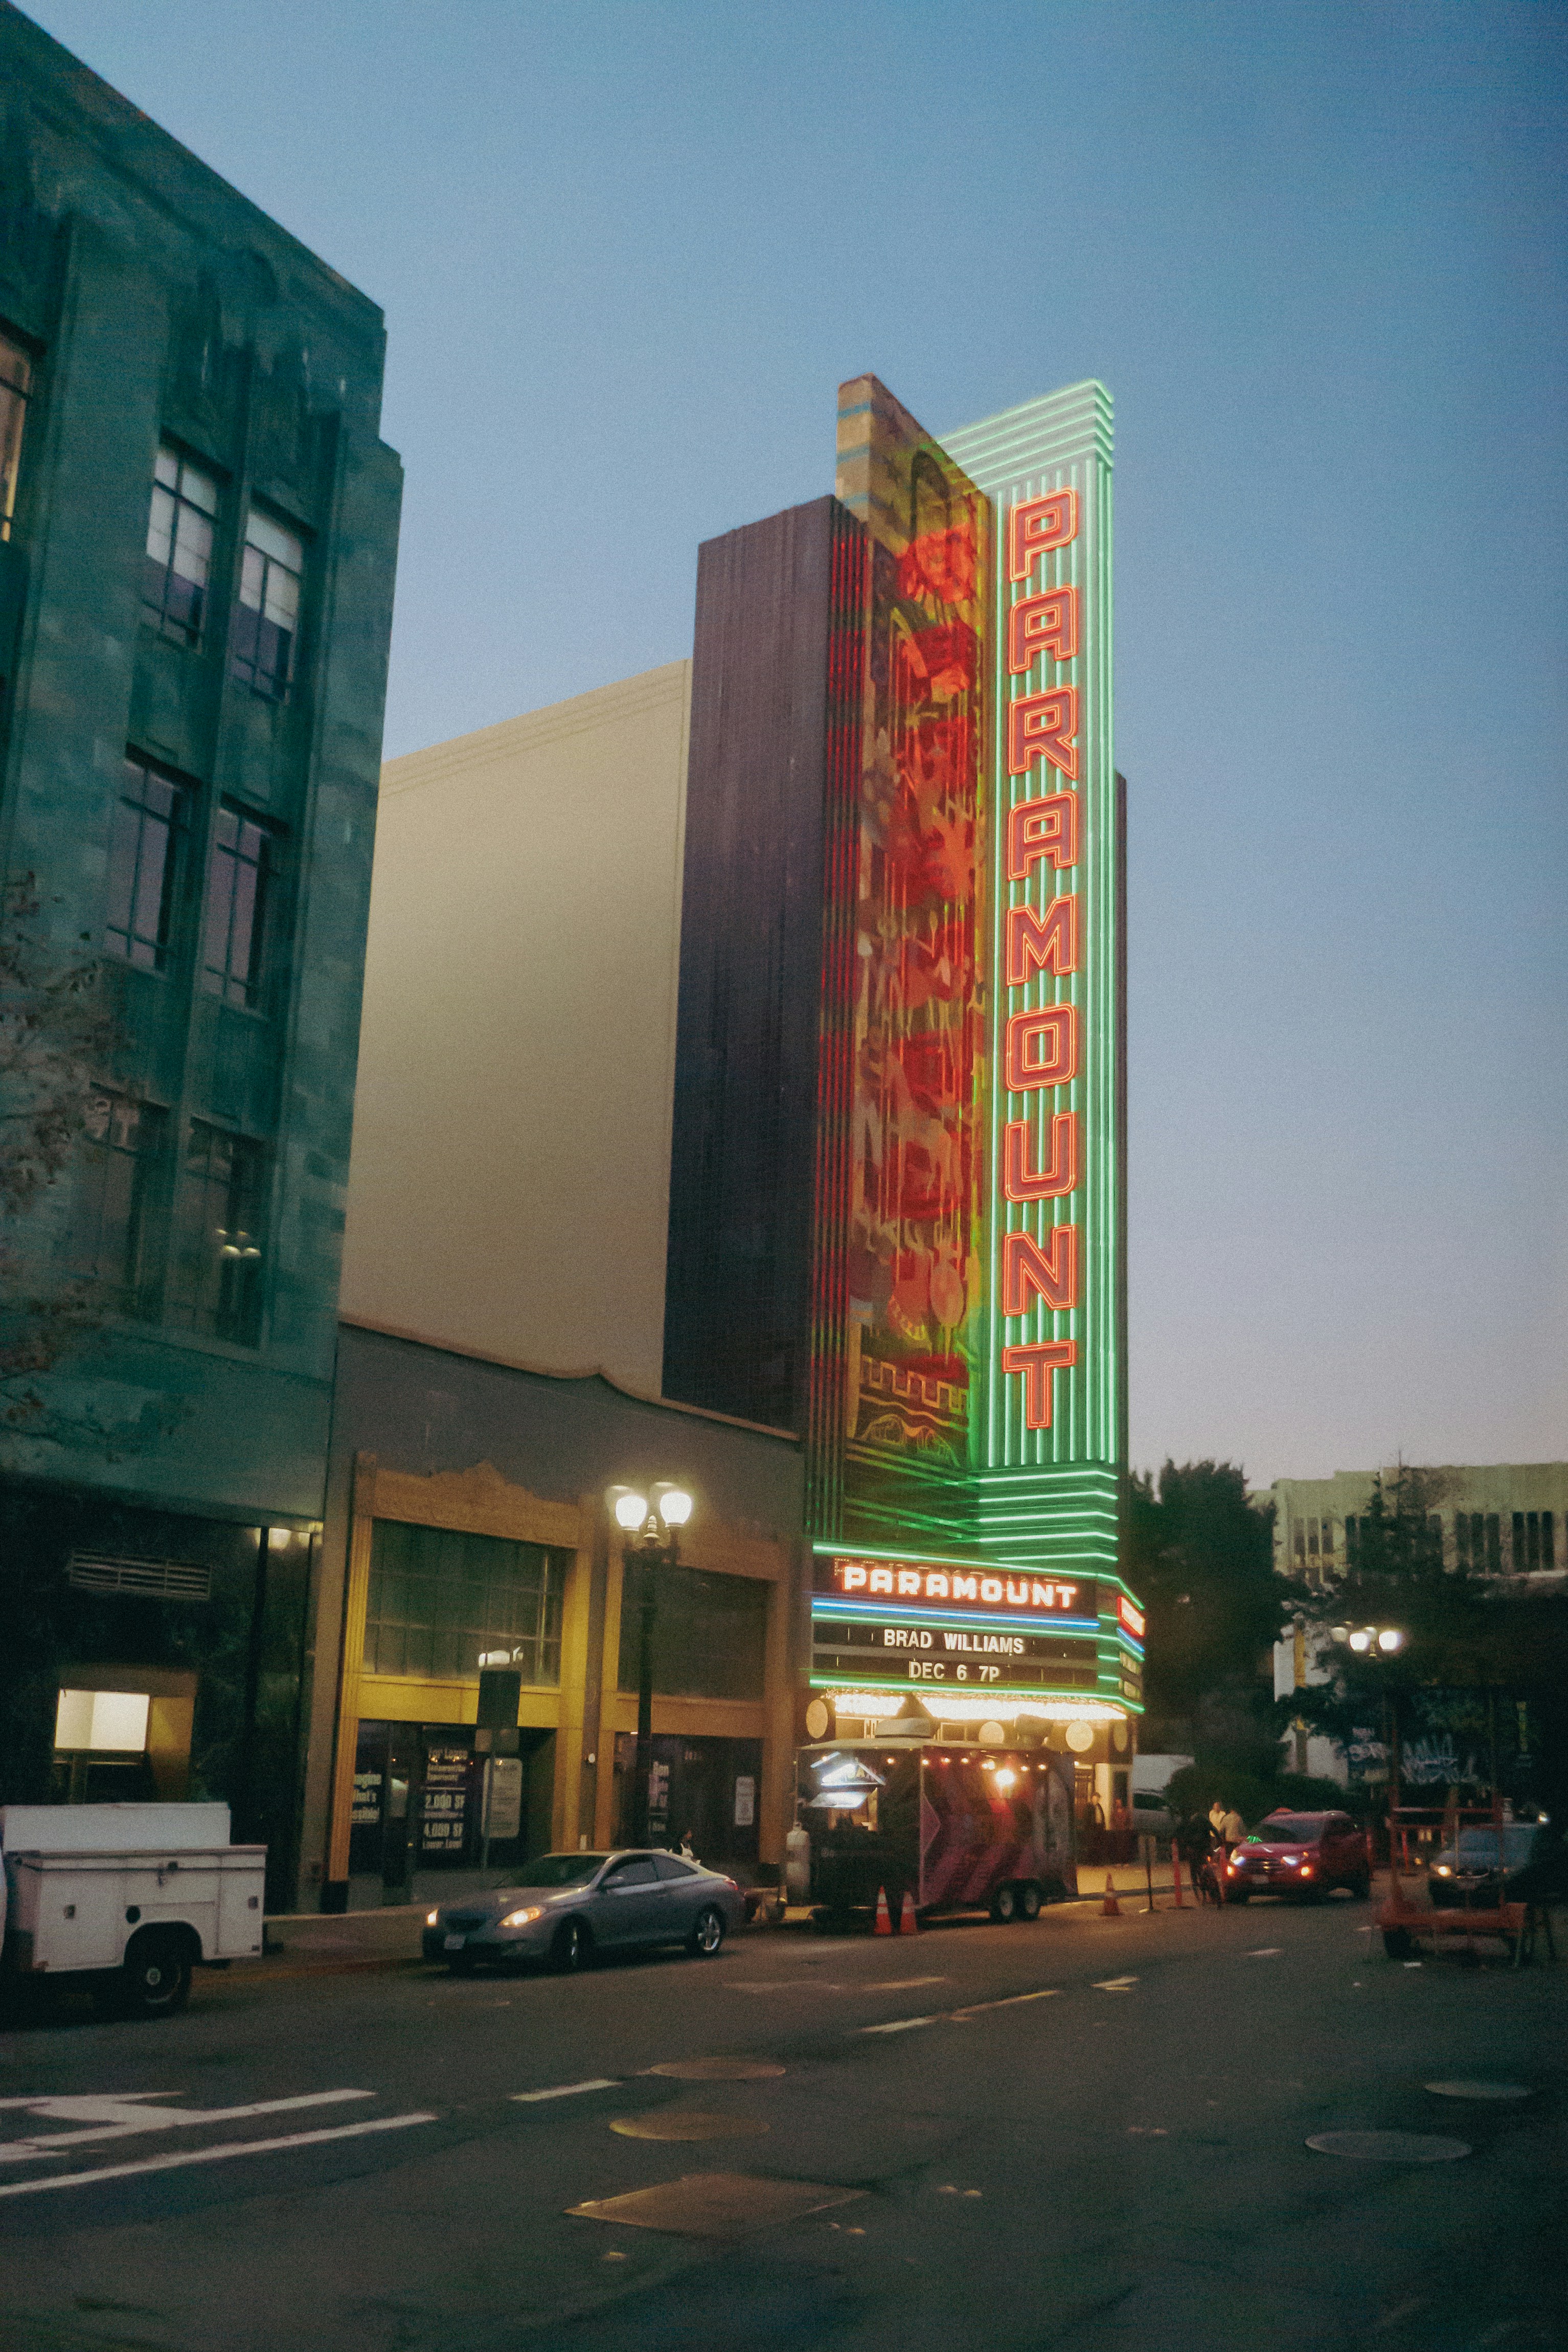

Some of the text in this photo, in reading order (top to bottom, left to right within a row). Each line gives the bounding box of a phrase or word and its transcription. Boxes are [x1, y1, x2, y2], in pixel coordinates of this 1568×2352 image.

[1002, 487, 1077, 1430] PARAMOUNT
[844, 1566, 1076, 1608] PARAMOUNT
[883, 1629, 1024, 1654] BRAD WILLIAMS
[910, 1661, 1000, 1683] DEC 6 7P
